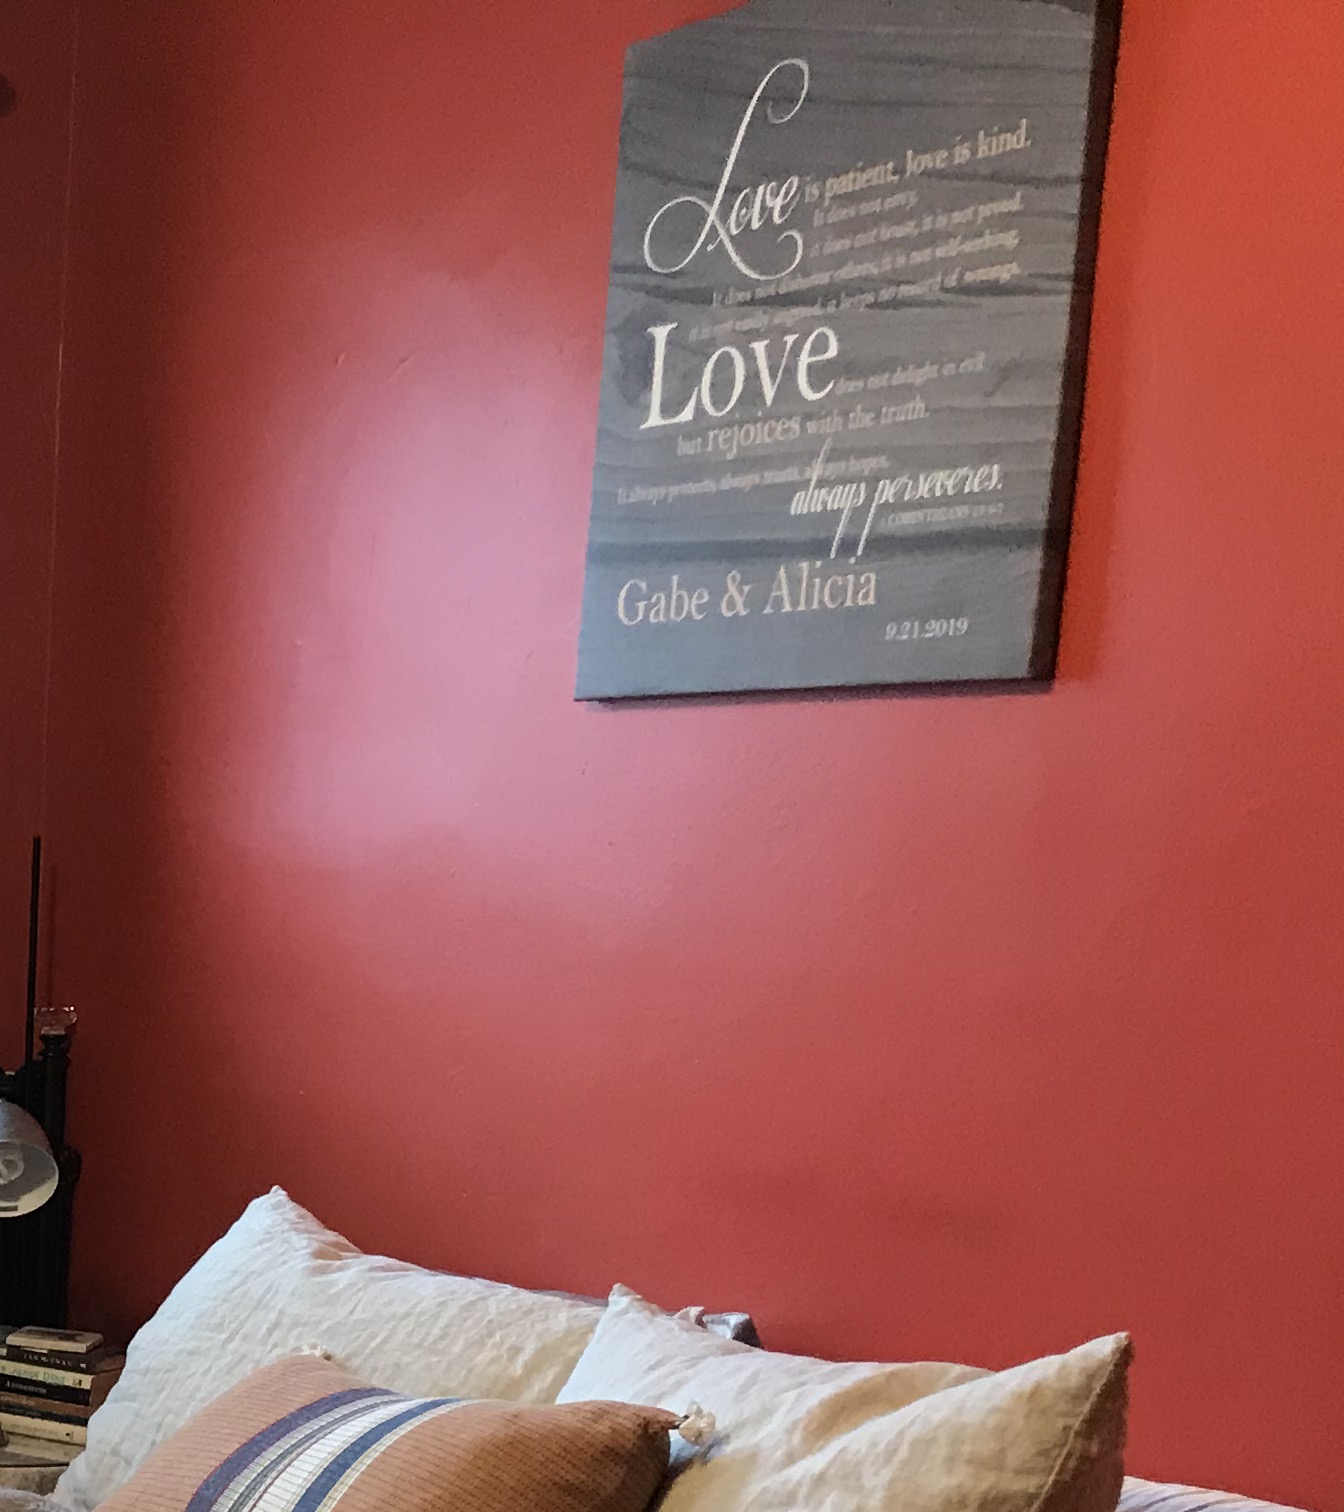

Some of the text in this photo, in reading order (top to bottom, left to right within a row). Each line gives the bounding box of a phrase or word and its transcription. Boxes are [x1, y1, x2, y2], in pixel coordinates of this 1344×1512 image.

[643, 58, 810, 281] Love
[639, 323, 839, 430] Love
[705, 410, 802, 461] rejoices
[790, 437, 1003, 560] always perseveres.
[616, 556, 877, 626] Gabe & Alicia
